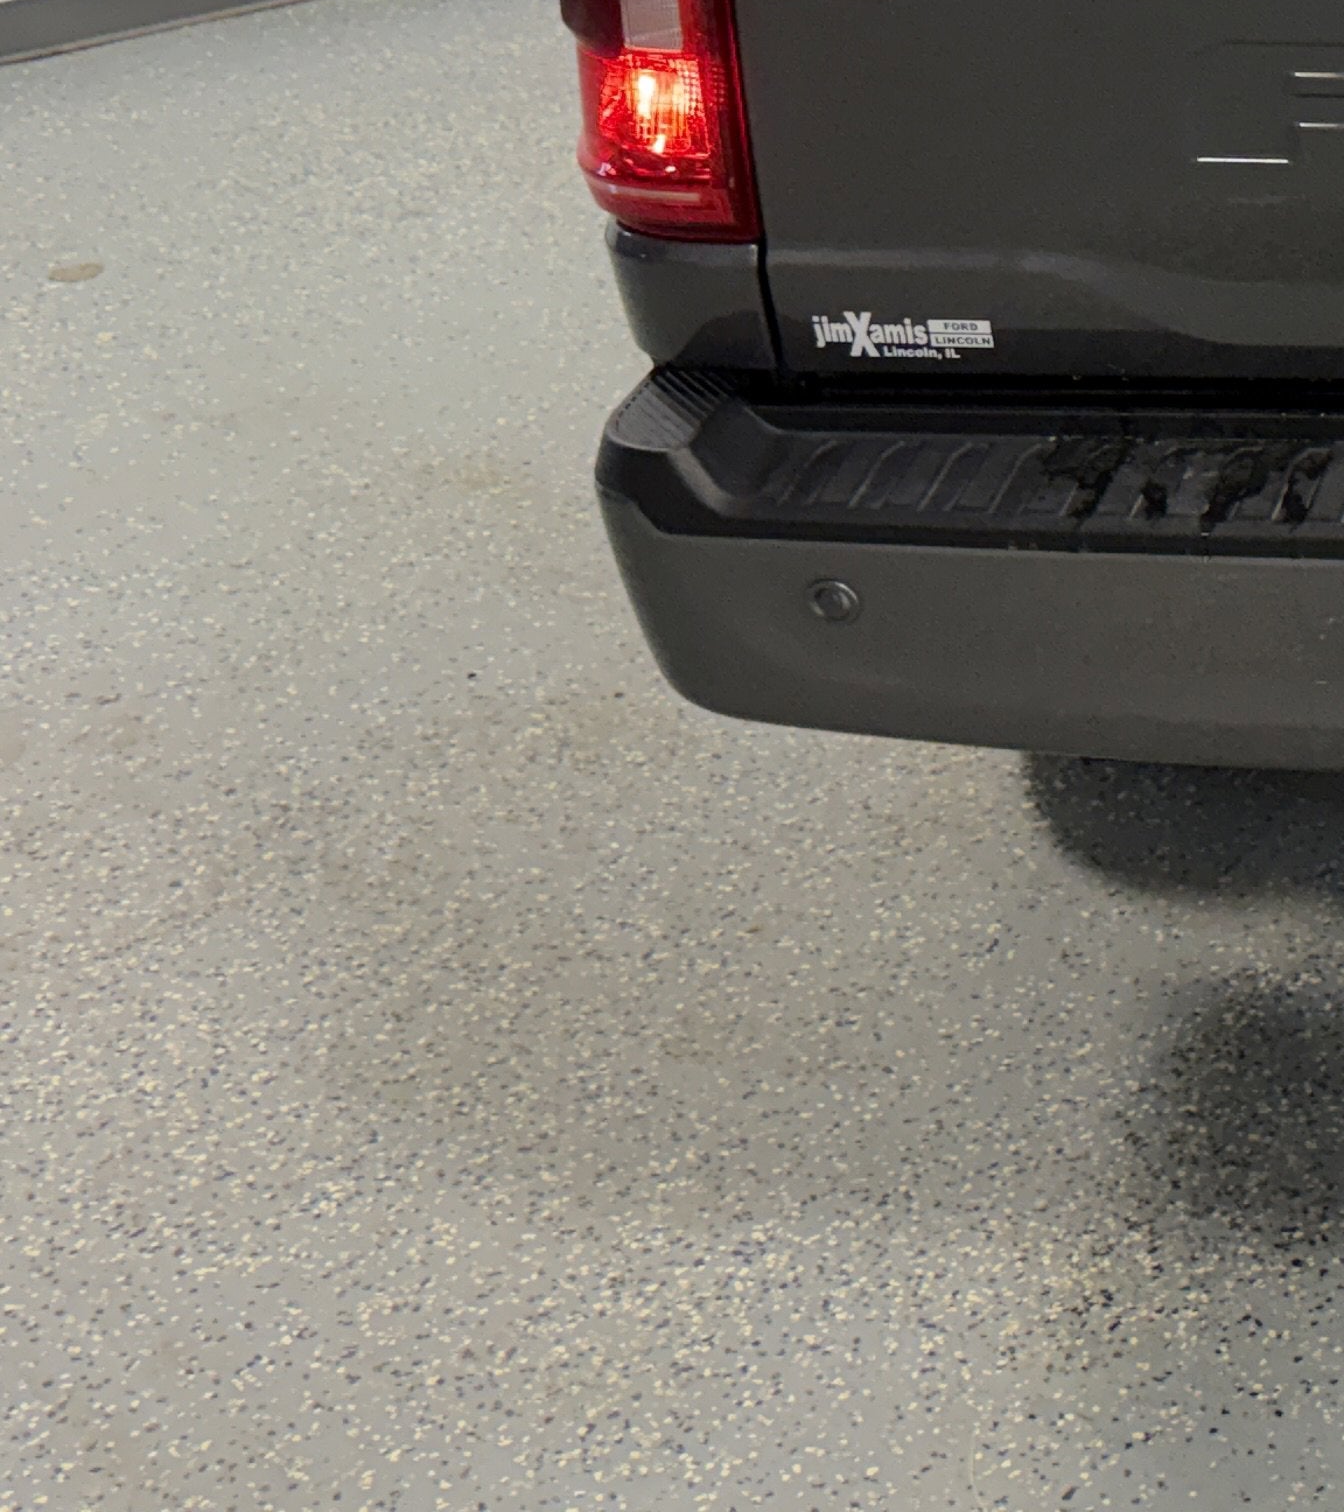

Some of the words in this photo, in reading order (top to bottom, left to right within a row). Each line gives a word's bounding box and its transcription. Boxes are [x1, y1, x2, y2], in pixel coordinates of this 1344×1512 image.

[942, 322, 979, 331] FORD
[935, 335, 992, 345] LINCOLN
[884, 346, 943, 360] Lincoln,
[945, 348, 961, 359] IL
